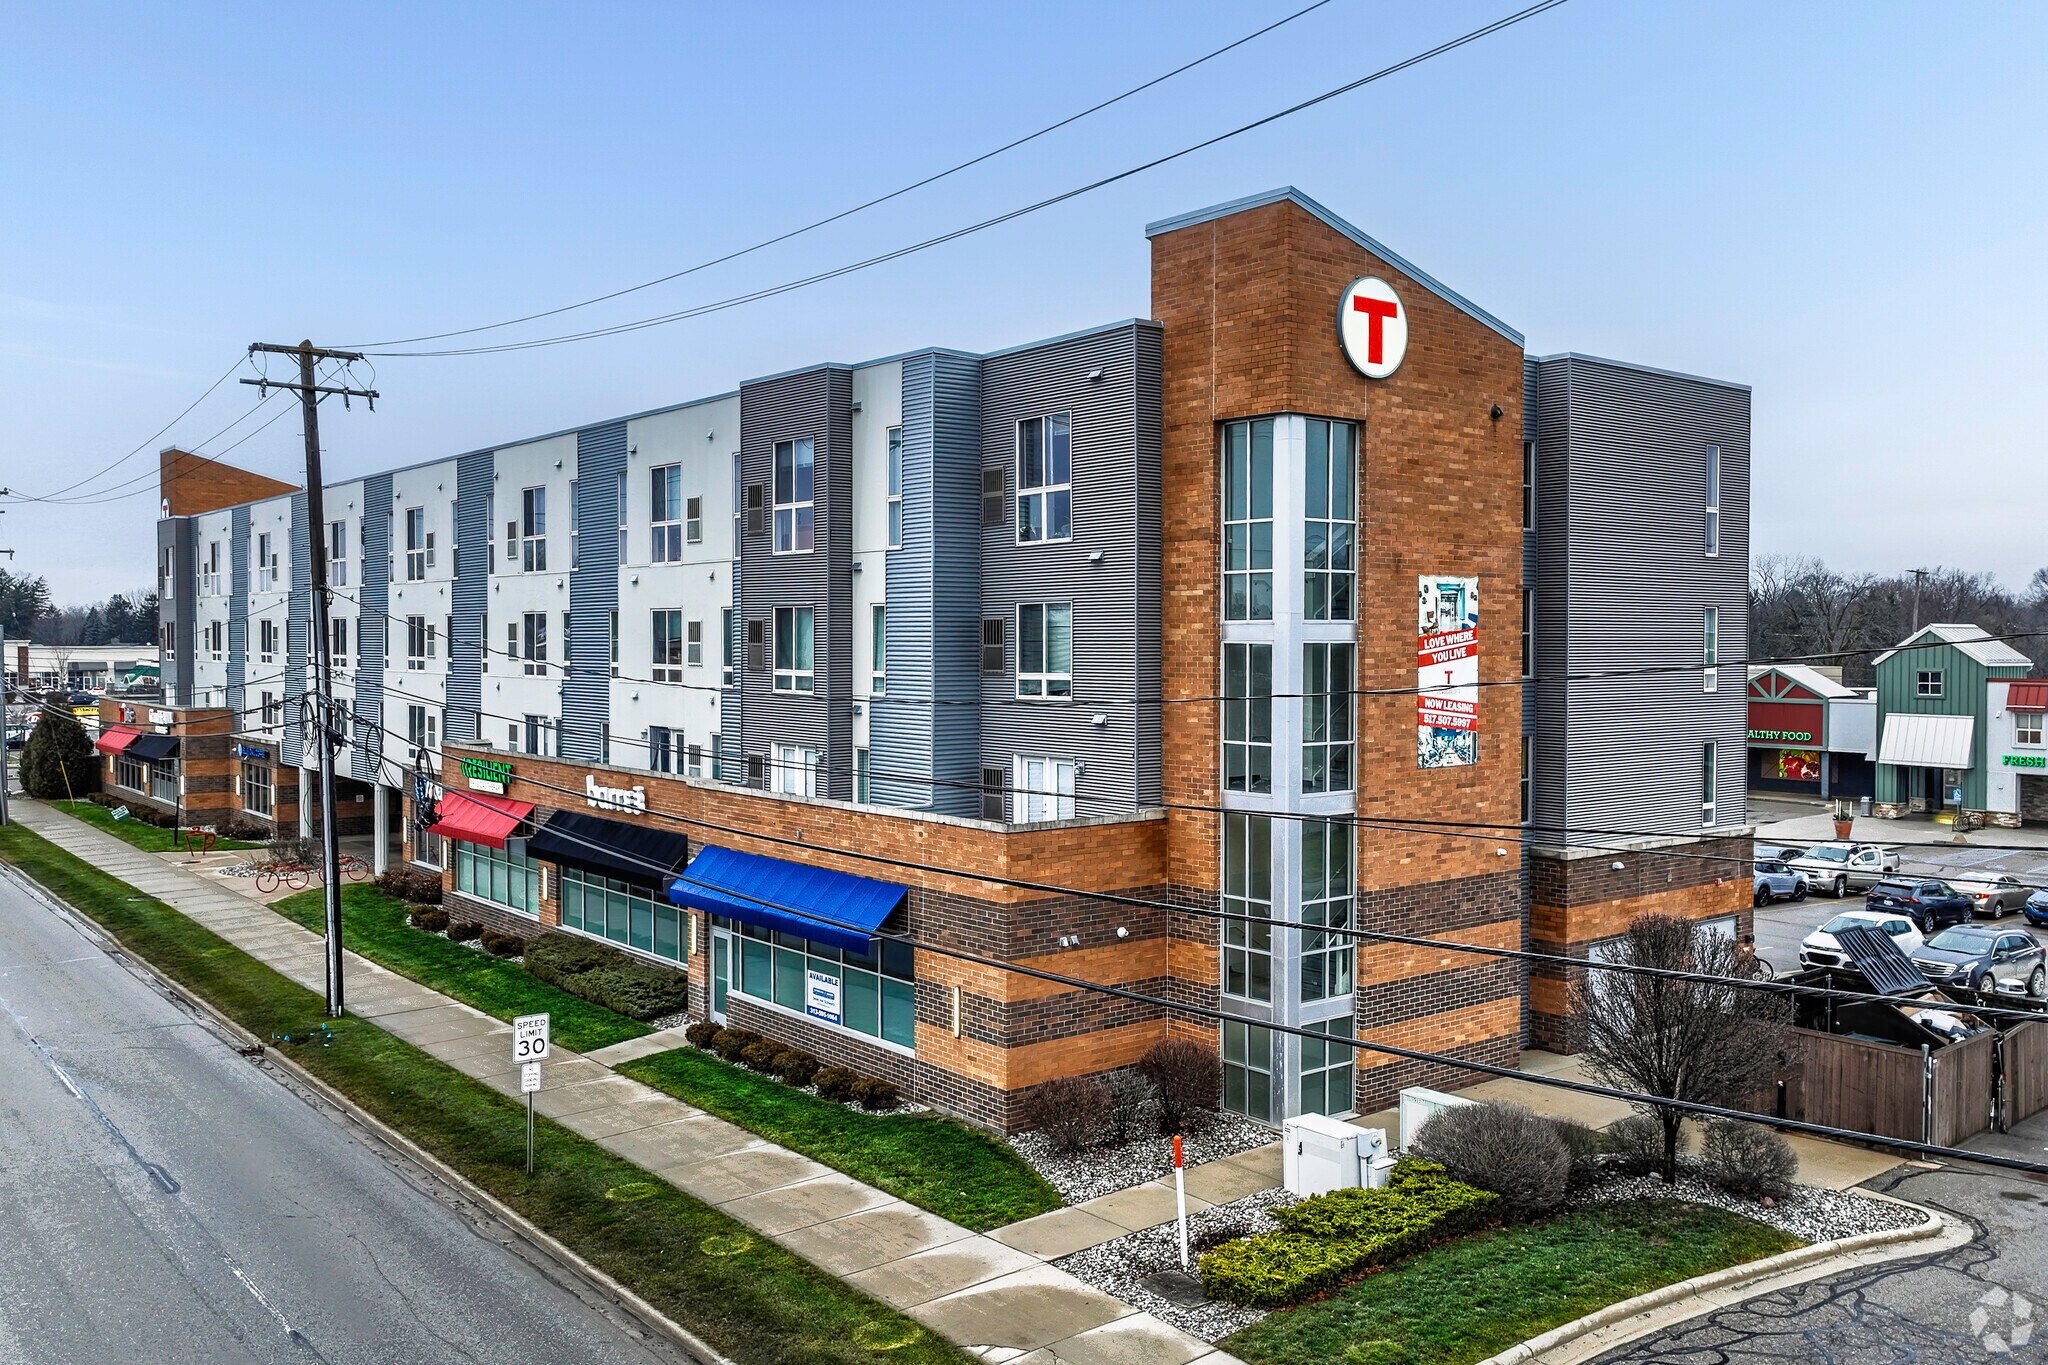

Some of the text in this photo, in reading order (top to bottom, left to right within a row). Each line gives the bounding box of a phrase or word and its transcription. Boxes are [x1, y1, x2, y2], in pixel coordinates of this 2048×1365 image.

[1354, 295, 1397, 364] T
[1424, 630, 1473, 650] LOVE WHERE
[1432, 647, 1467, 663] YOU LIVE
[1444, 670, 1453, 685] T
[1425, 698, 1473, 713] NOW LEASING
[1747, 729, 1812, 741] ALTHY FOOD
[2002, 755, 2046, 768] FRESH
[809, 972, 838, 986] AVAILABLE
[517, 1019, 546, 1030] SPEED
[520, 1029, 542, 1039] LIMIT
[518, 1038, 545, 1056] 30
